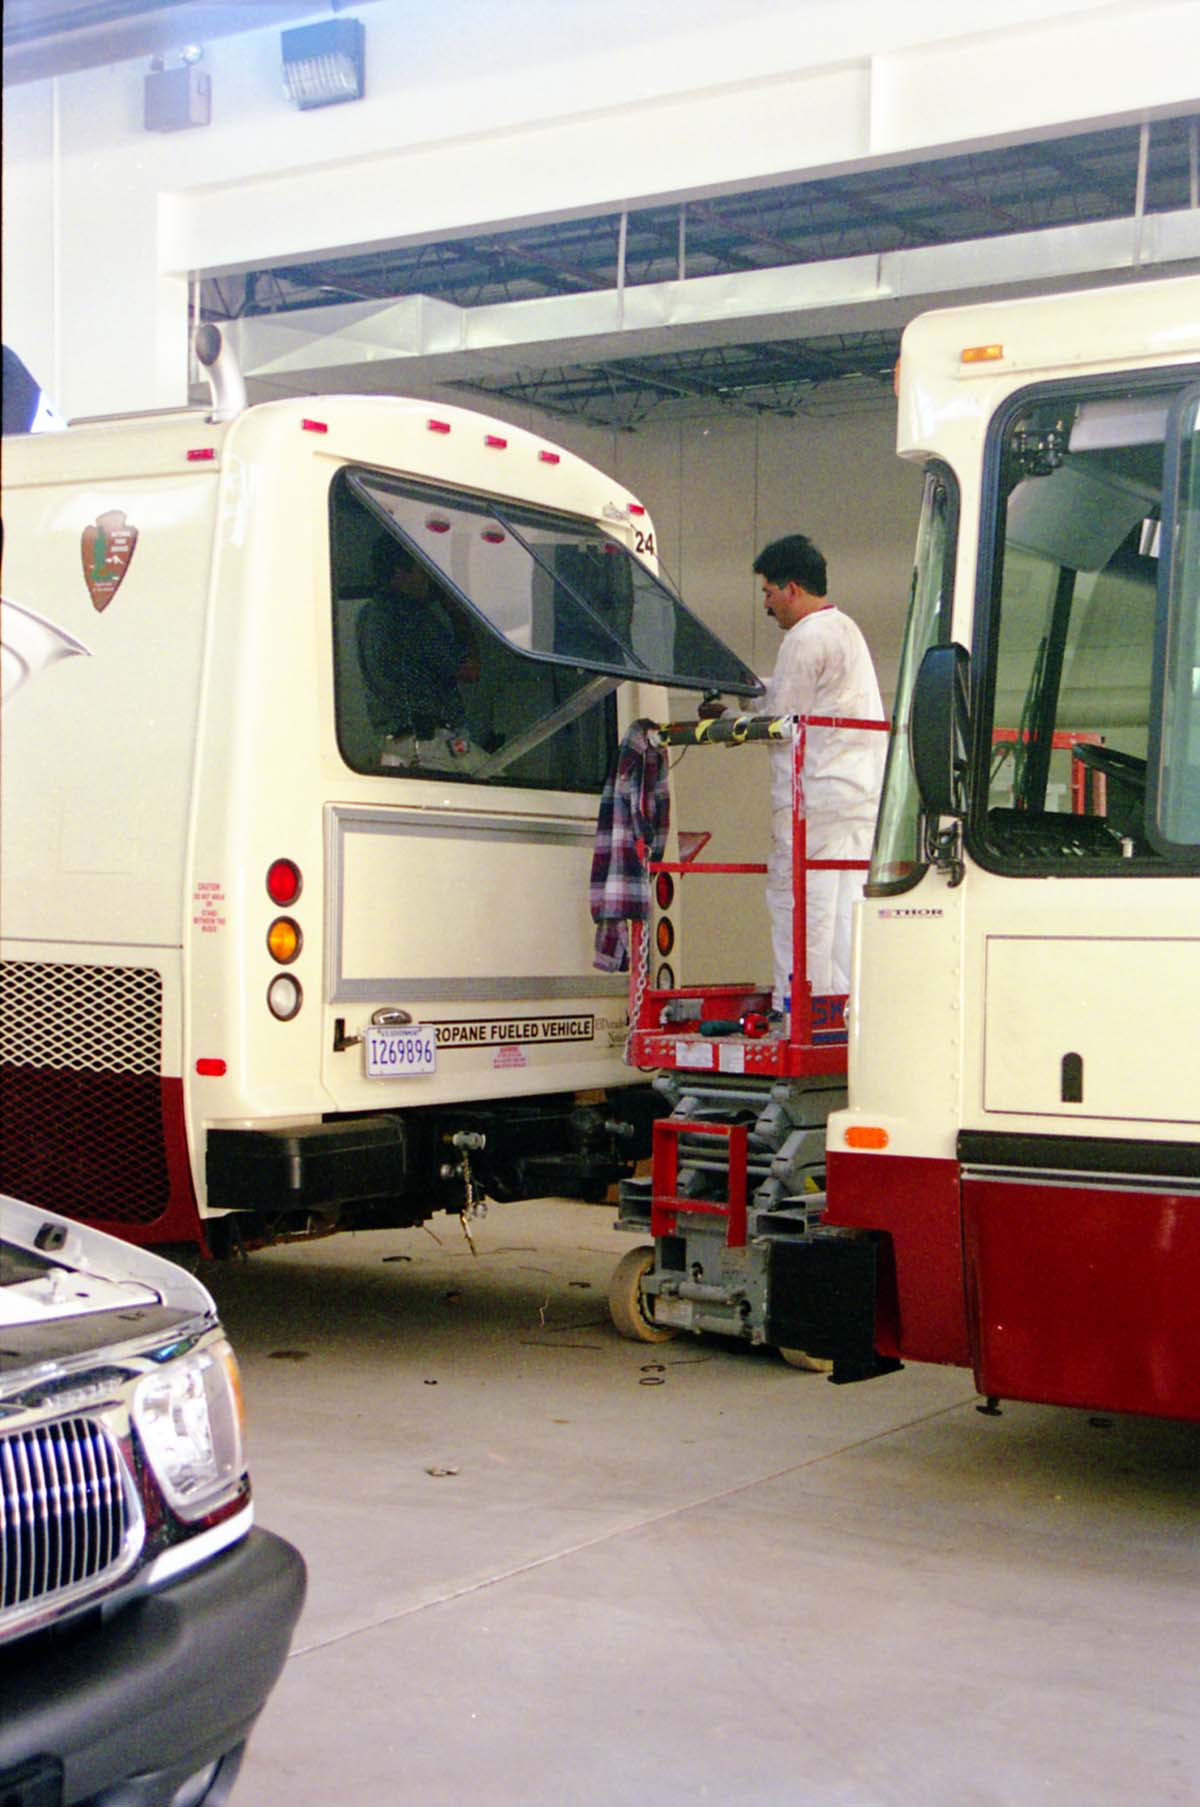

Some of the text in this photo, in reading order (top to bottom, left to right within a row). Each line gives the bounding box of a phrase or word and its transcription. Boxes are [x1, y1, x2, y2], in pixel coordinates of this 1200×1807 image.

[635, 531, 654, 555] 24
[894, 908, 943, 916] THOR
[811, 997, 844, 1024] SK
[434, 1026, 486, 1042] ROPANE
[490, 1023, 539, 1040] FUELED
[542, 1020, 590, 1037] VEHICLE
[372, 1039, 432, 1064] I269896
